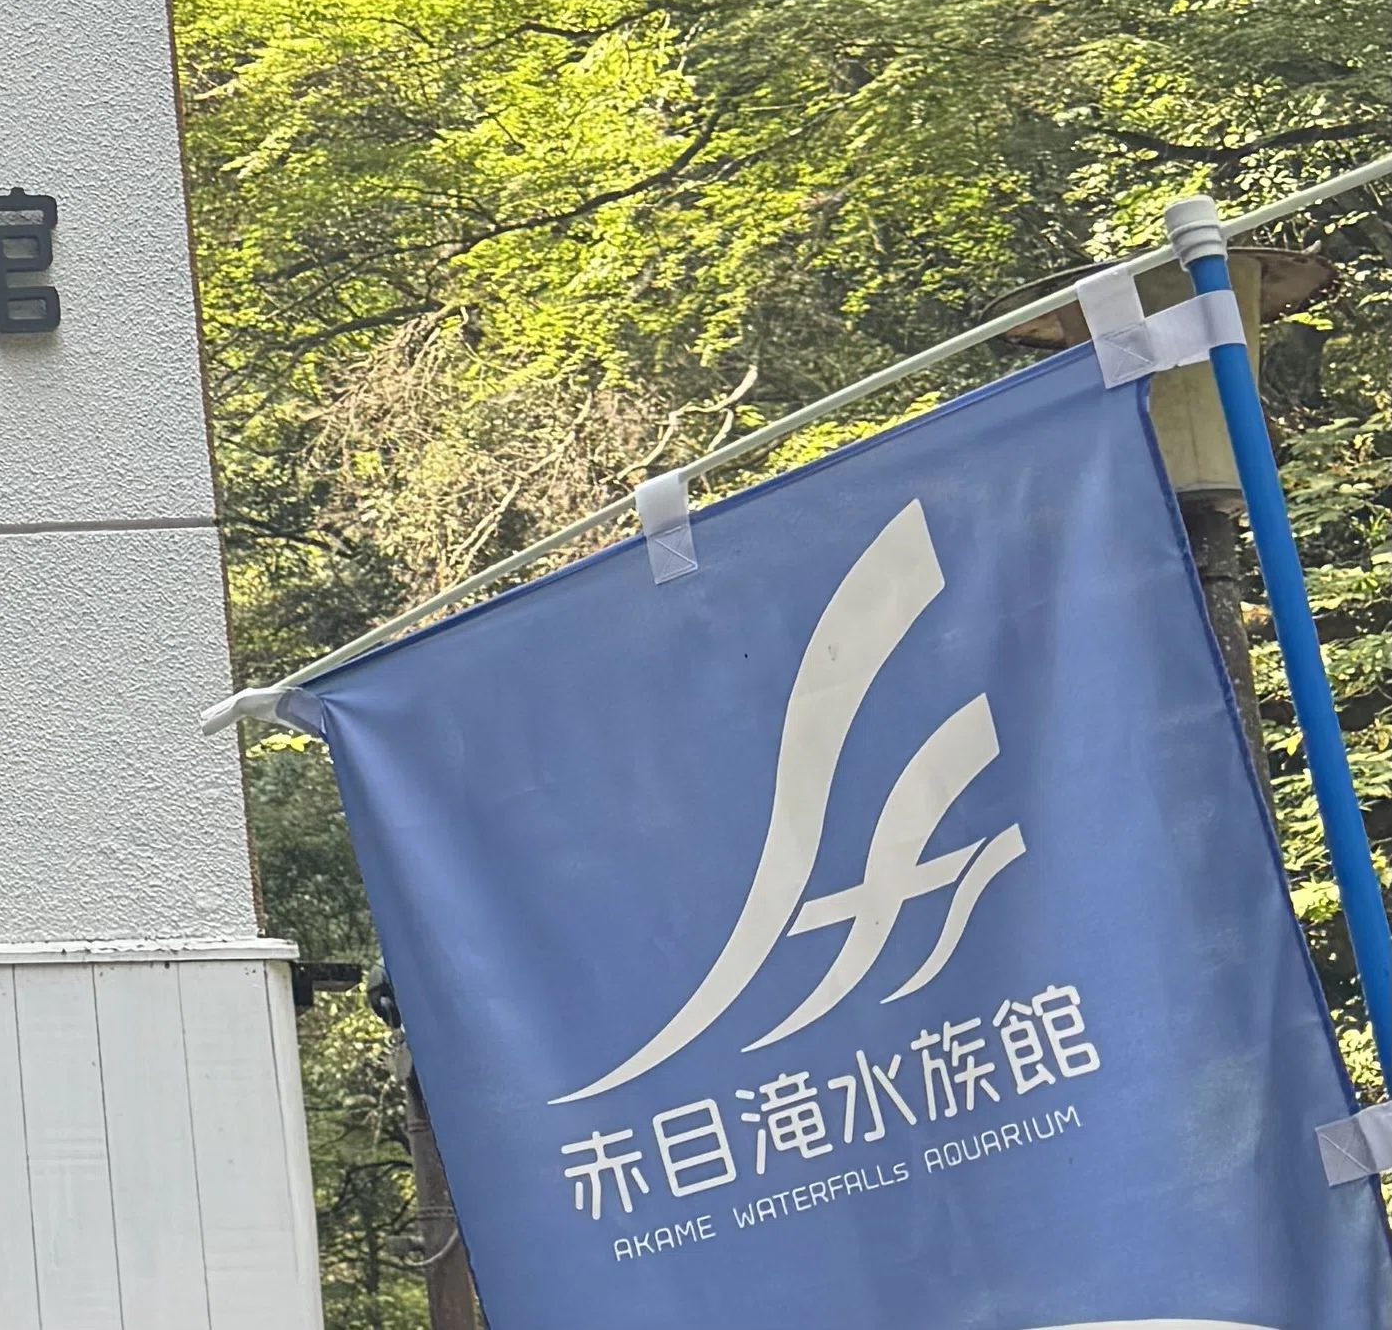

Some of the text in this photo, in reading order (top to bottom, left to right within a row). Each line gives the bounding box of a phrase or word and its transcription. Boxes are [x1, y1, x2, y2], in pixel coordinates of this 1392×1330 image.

[561, 984, 1101, 1221] 赤目滝水族館
[613, 1215, 717, 1262] AKAME
[923, 1105, 1082, 1174] AQUARIUM
